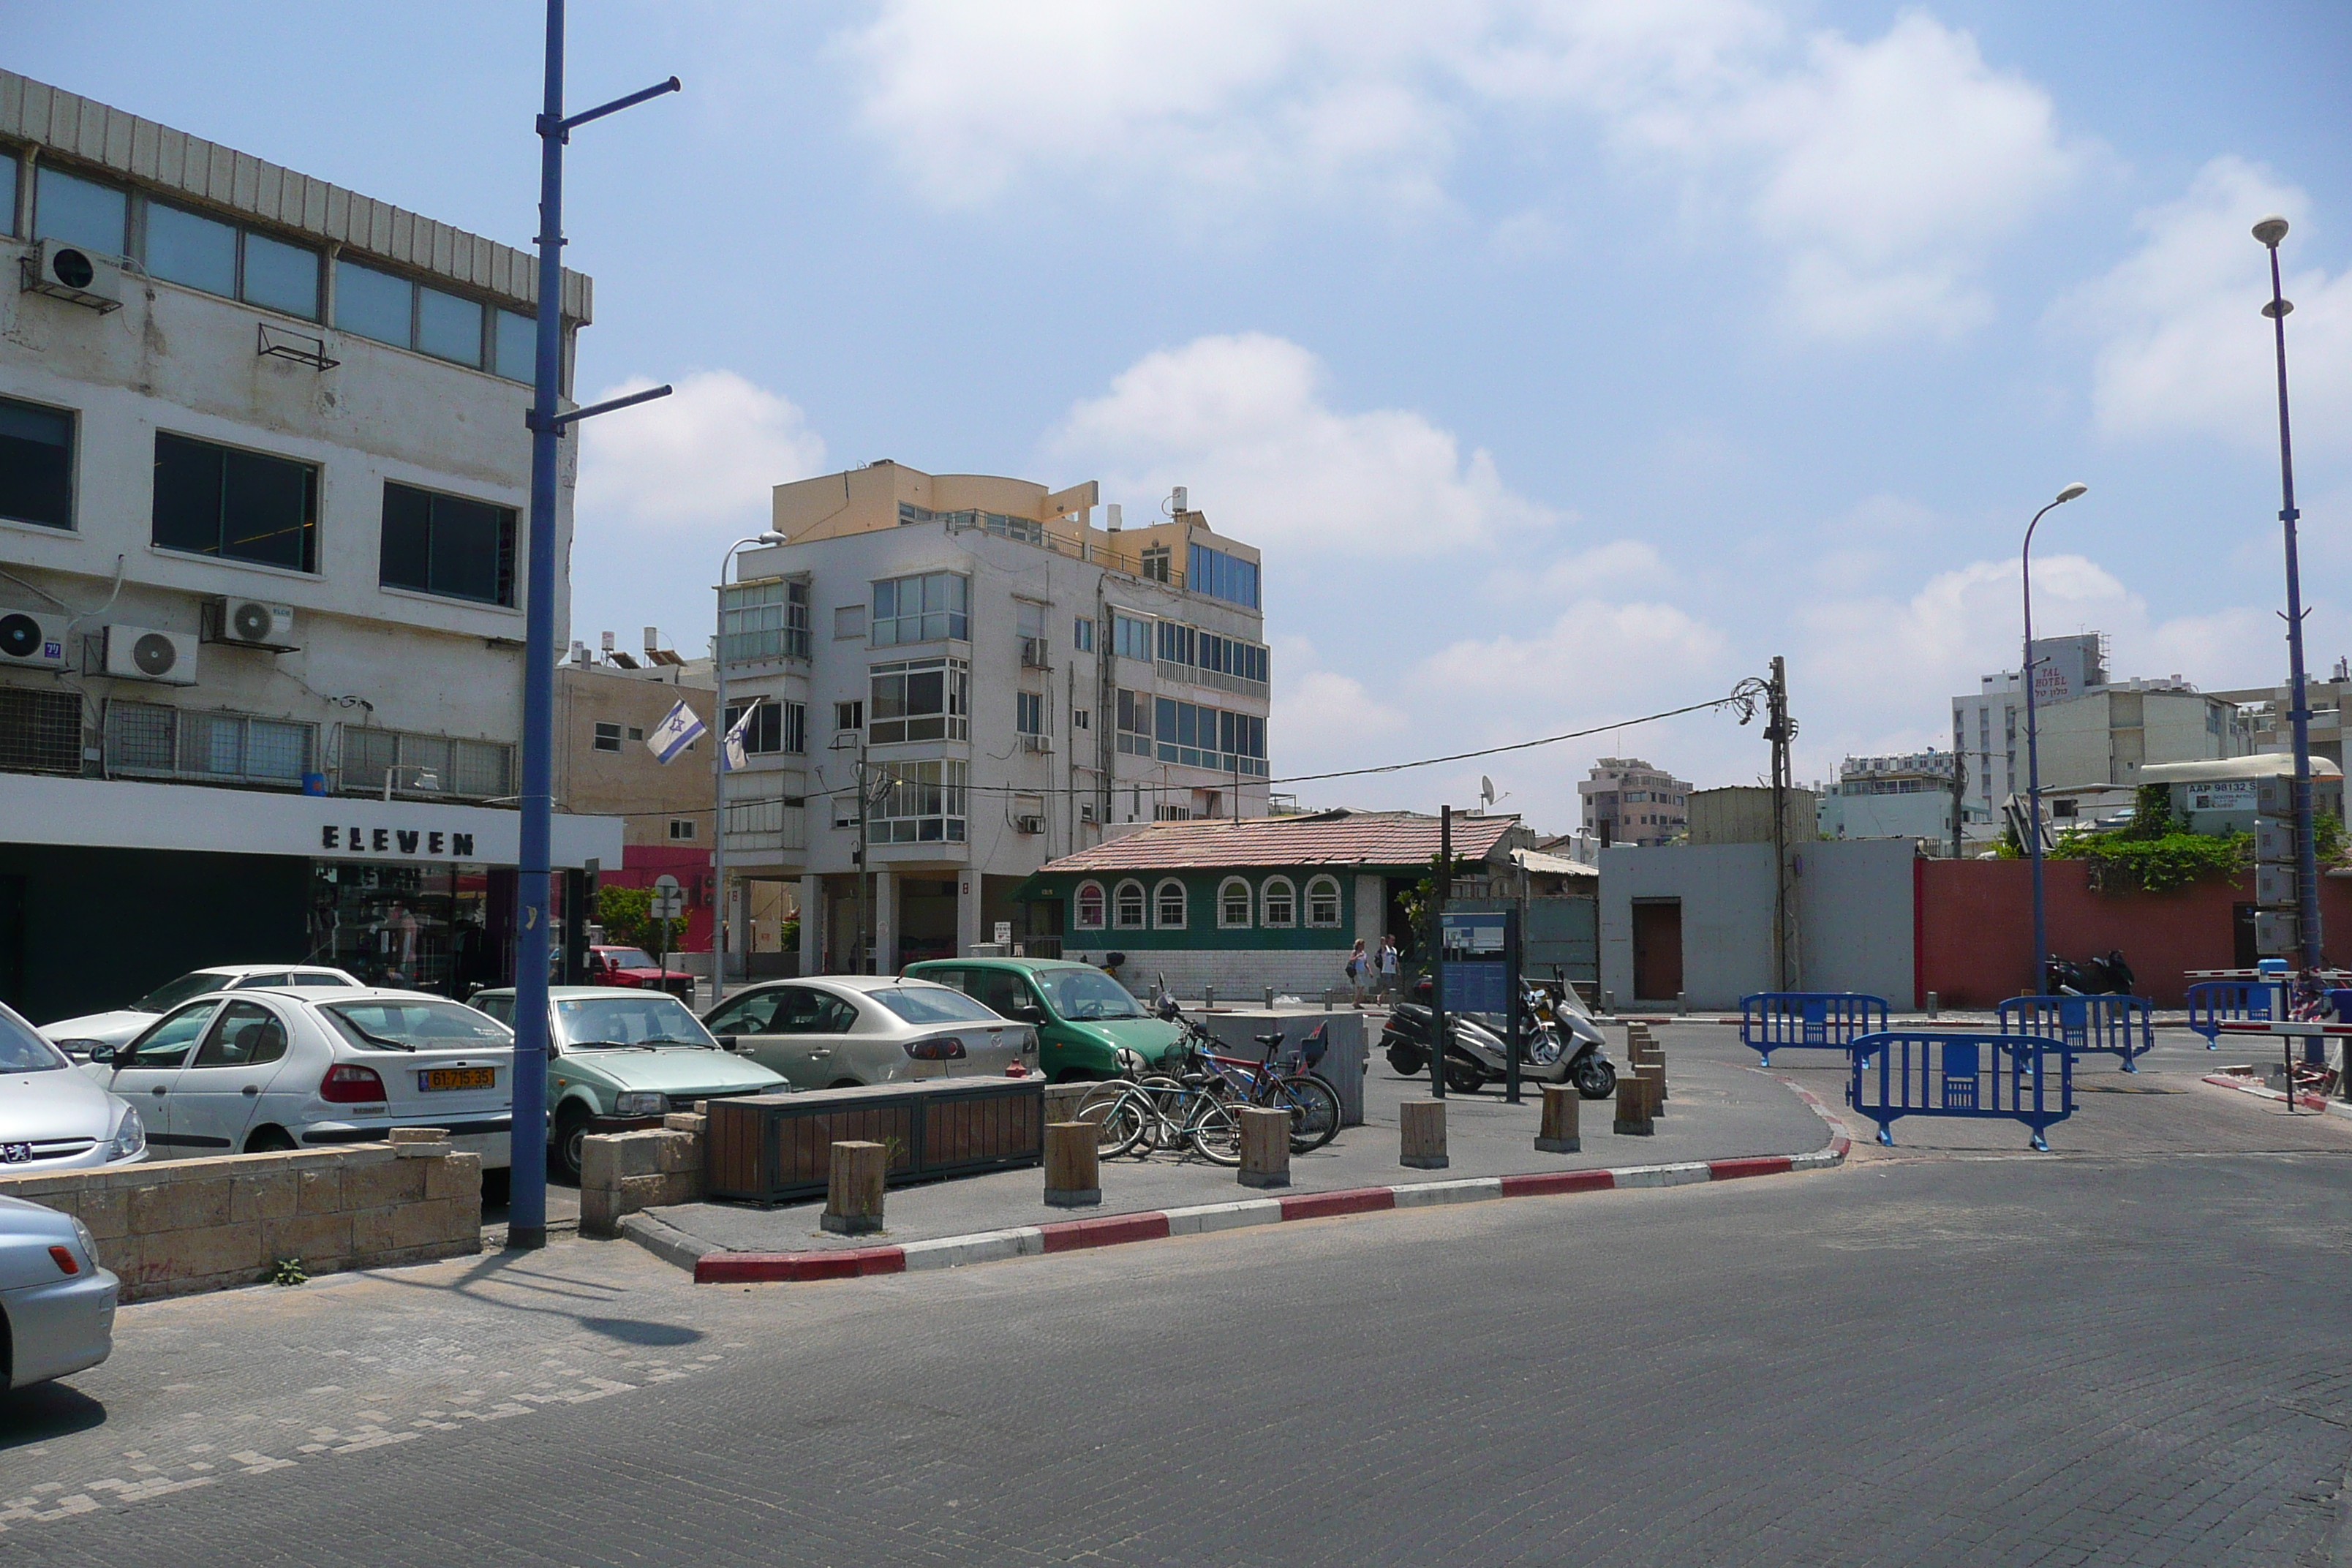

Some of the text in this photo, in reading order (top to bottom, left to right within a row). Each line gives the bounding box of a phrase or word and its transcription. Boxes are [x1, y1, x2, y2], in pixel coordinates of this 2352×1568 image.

[2042, 668, 2059, 676] TAL
[2035, 676, 2067, 687] HOTEL
[2050, 687, 2068, 697] מלון
[2189, 785, 2211, 793] AAP
[2215, 783, 2246, 791] 98132
[323, 825, 474, 856] ELEVEN
